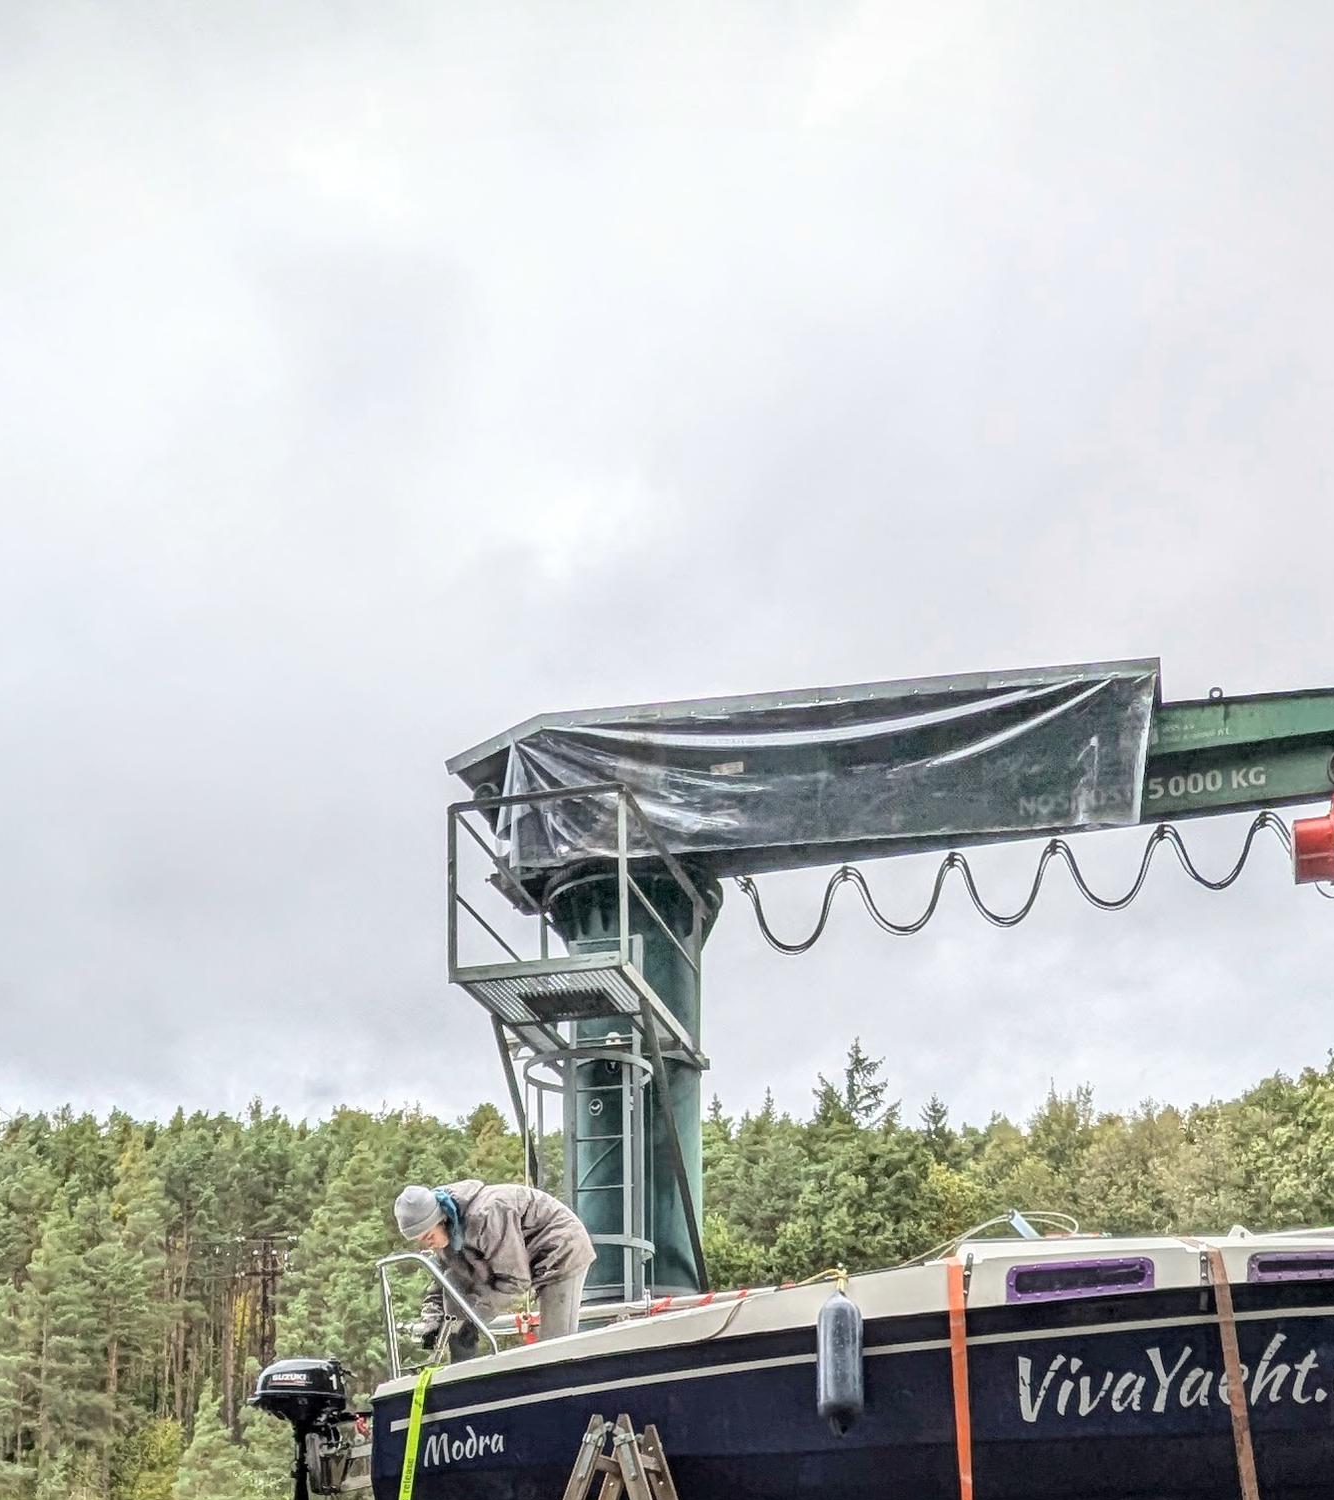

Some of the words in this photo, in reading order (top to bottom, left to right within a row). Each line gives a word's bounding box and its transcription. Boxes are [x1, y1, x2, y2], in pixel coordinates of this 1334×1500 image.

[1230, 766, 1267, 790] KG
[271, 1373, 307, 1381] SUZUKI
[423, 1425, 505, 1468] Modra
